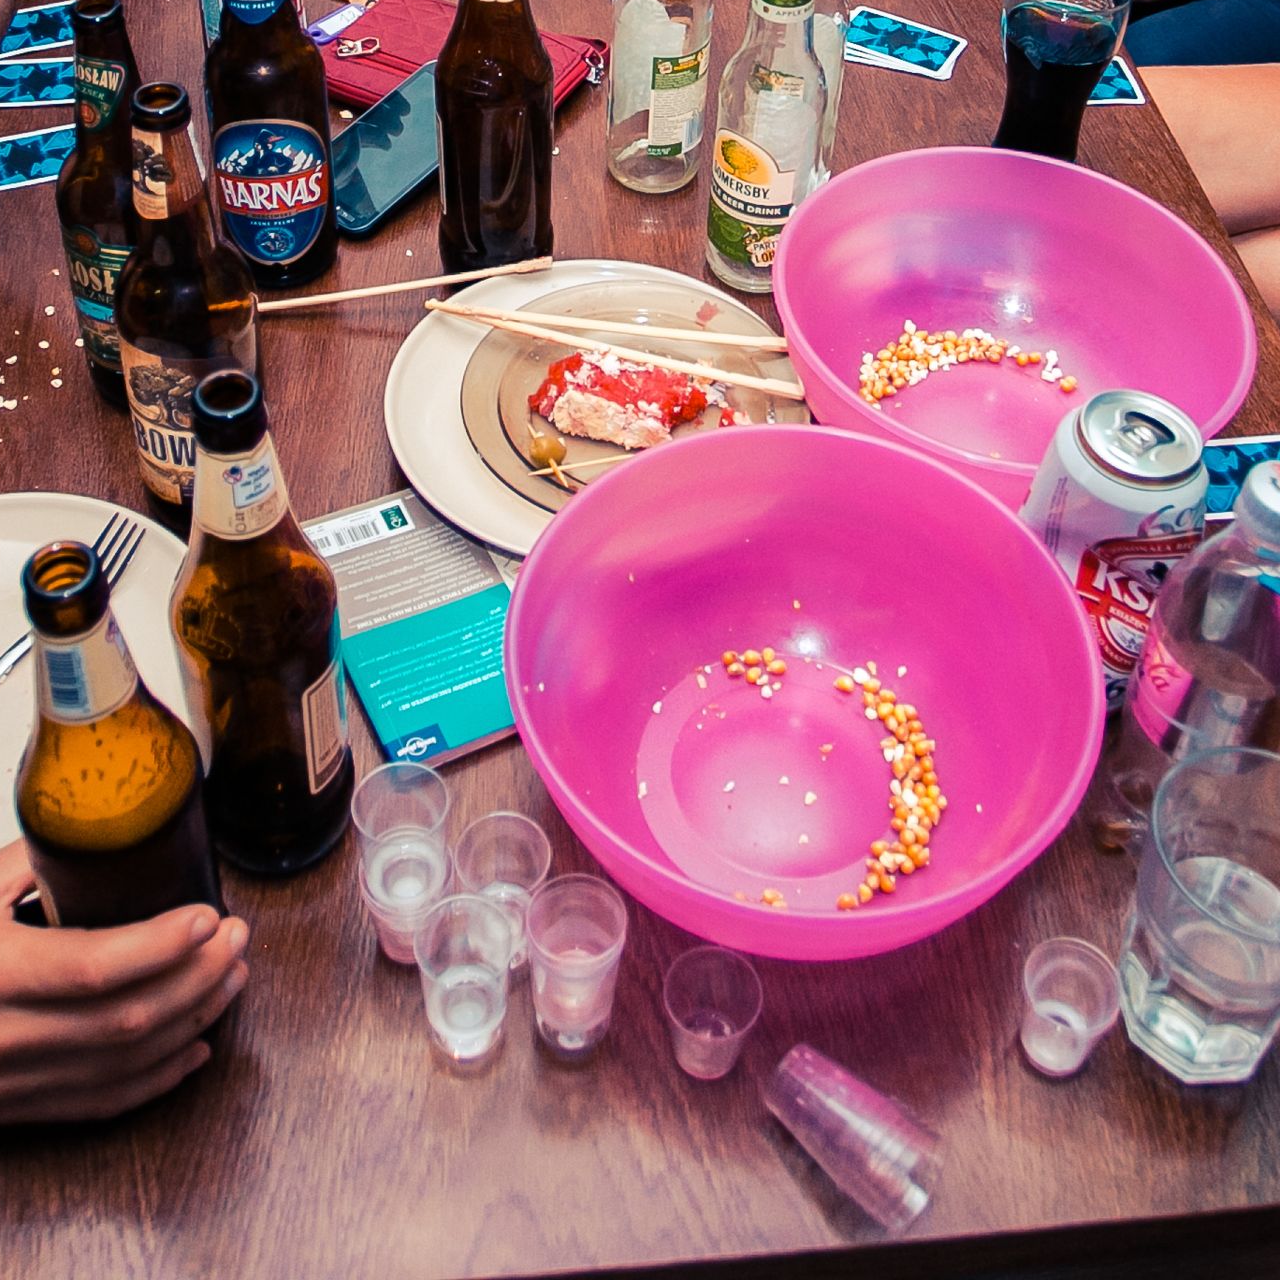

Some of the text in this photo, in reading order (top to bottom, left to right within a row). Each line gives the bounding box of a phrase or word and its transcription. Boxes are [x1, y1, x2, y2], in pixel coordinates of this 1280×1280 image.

[77, 64, 120, 92] OSŁAW
[219, 166, 322, 210] HARNAŚ
[722, 191, 781, 216] BEER DRINK
[754, 241, 776, 252] PART
[71, 260, 116, 296] OSŁ
[135, 418, 197, 467] BOW
